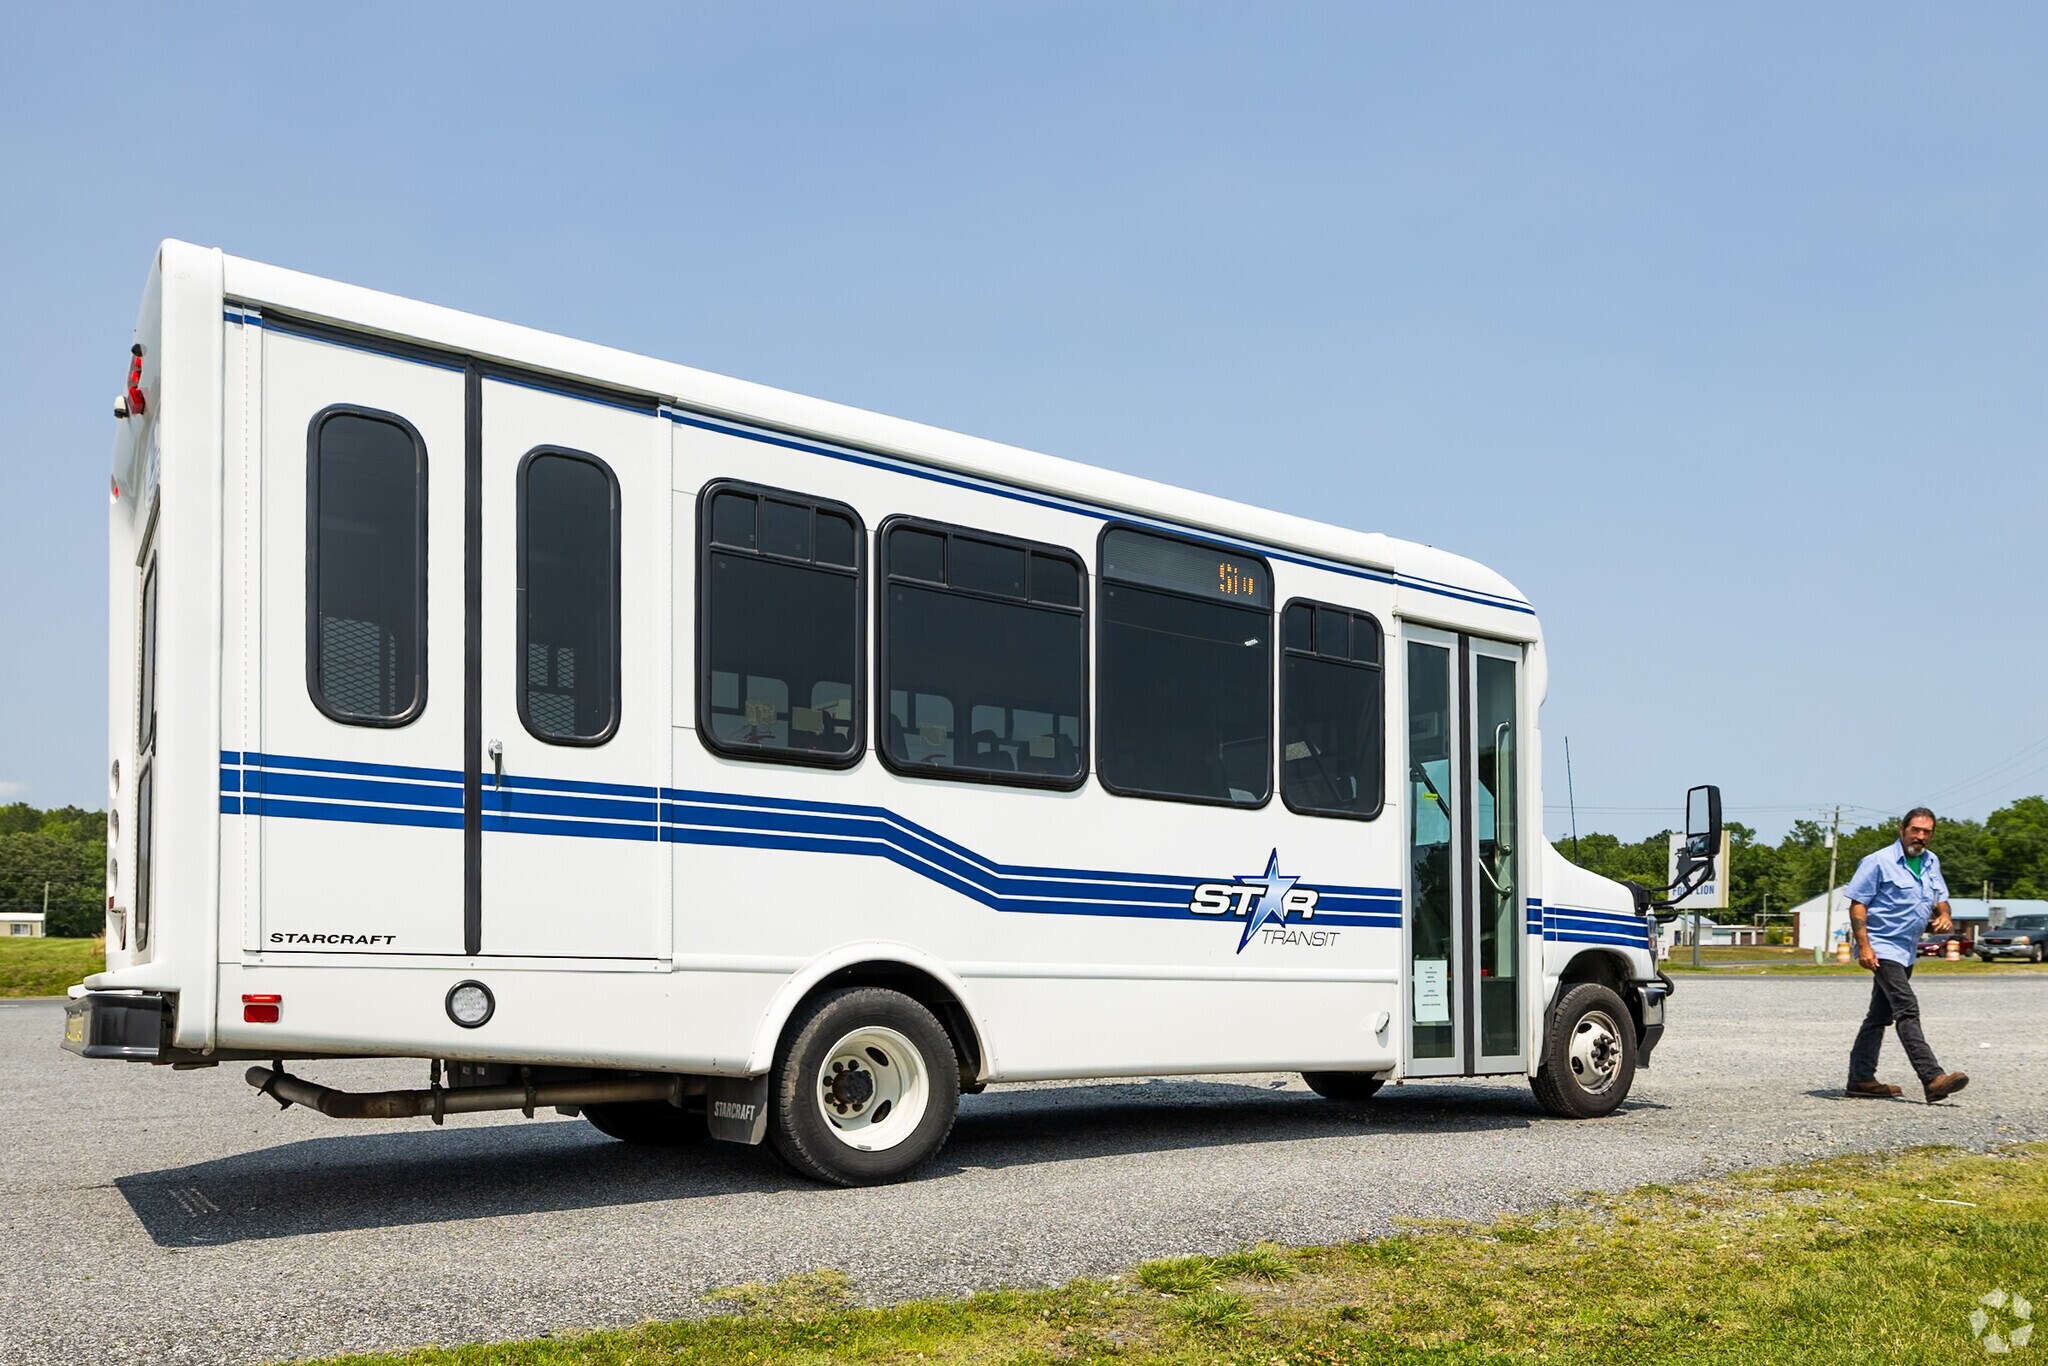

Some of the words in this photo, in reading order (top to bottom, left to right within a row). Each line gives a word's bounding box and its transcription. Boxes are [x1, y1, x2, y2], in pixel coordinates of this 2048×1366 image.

[1696, 885, 1715, 896] LION
[269, 932, 397, 945] STARCRAFT
[1262, 929, 1341, 947] TRANSIT
[713, 1100, 756, 1121] STARCRAFT
